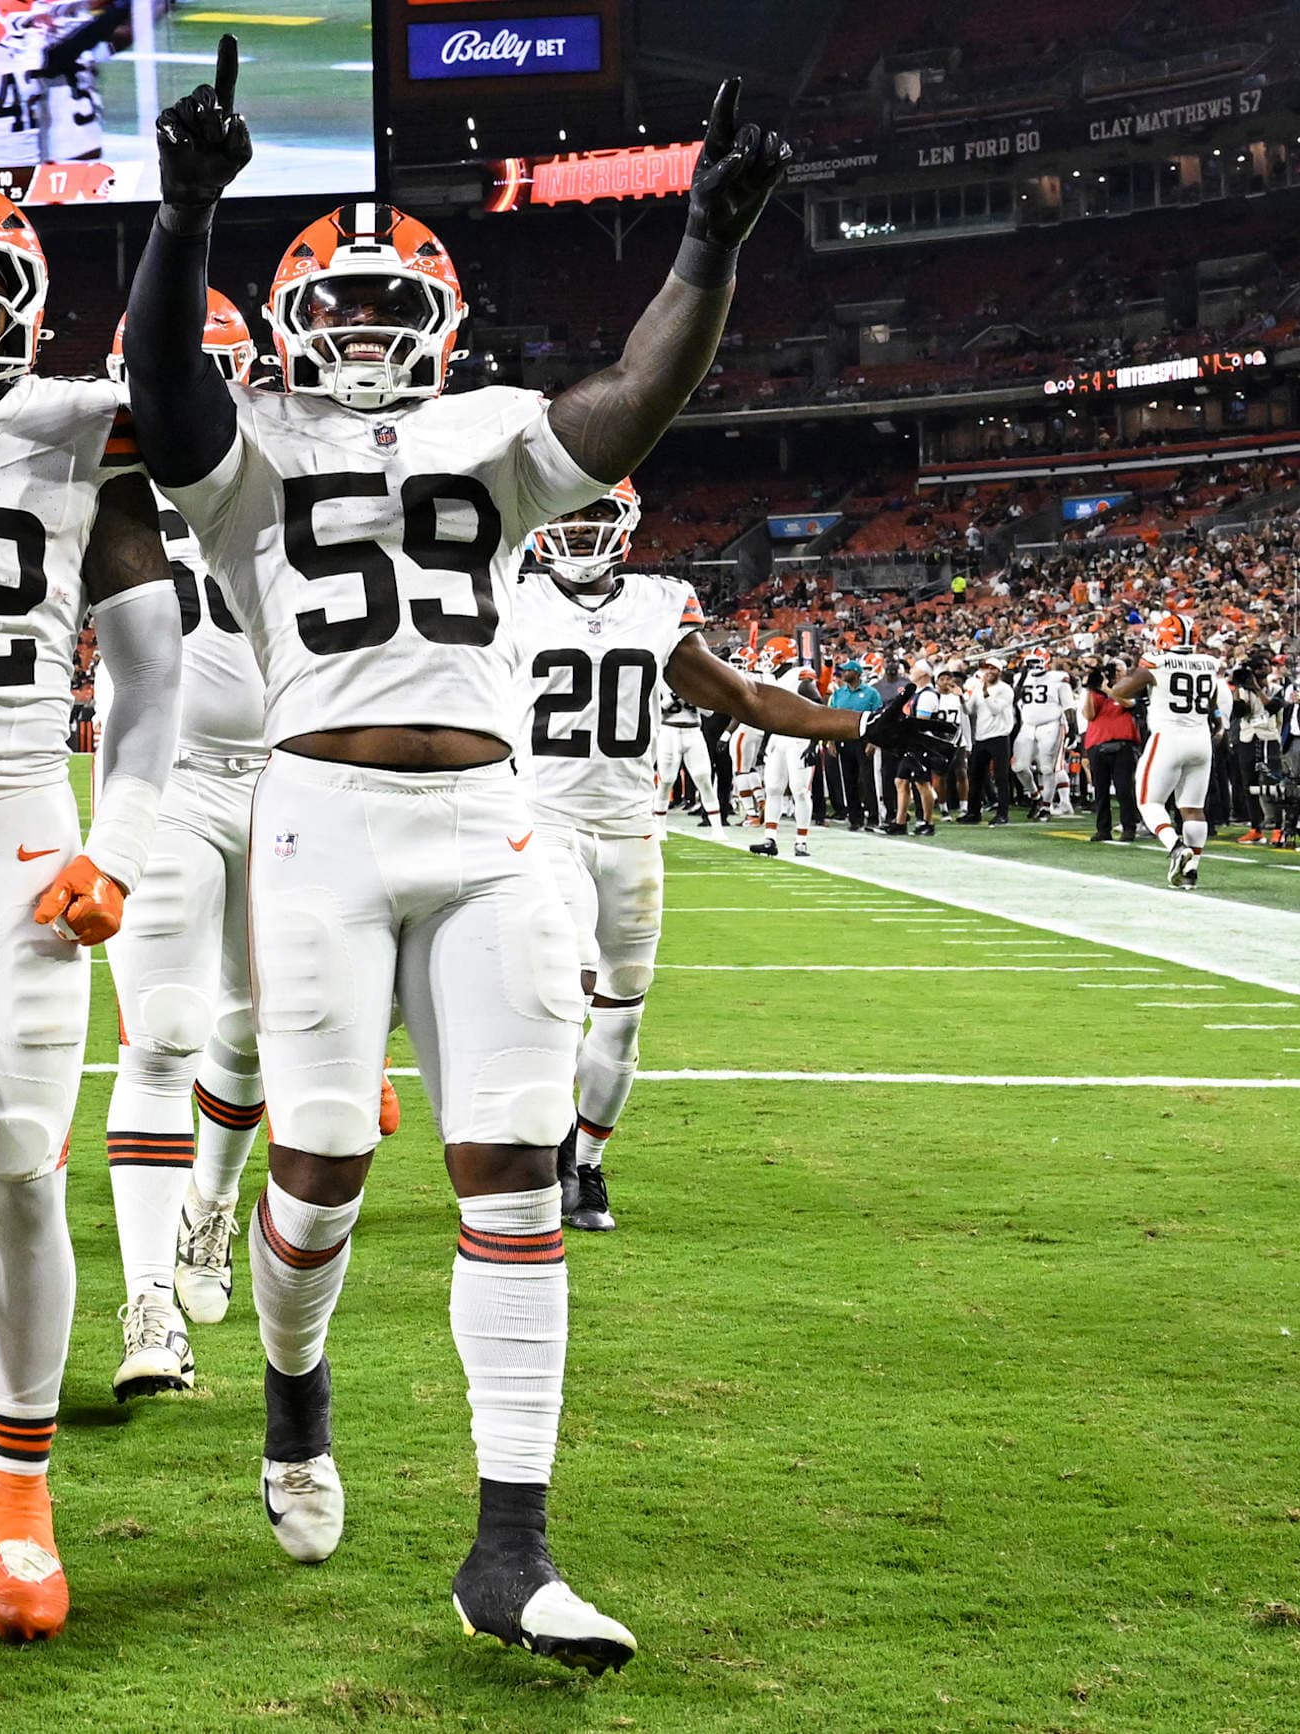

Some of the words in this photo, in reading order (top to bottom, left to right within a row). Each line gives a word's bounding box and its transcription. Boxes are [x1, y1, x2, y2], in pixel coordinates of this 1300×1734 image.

[441, 29, 532, 67] Bally
[536, 38, 566, 57] BET
[1089, 117, 1133, 141] CLAY
[1135, 96, 1232, 135] MATTHEWS
[1238, 89, 1263, 115] 57
[786, 154, 879, 176] CROSSCOUNTRY
[918, 146, 955, 167] LEN
[964, 137, 1010, 161] FORD
[1015, 131, 1041, 153] 80
[49, 171, 68, 195] 17
[282, 470, 503, 656] 59
[1164, 658, 1216, 671] HUNTINGTON
[531, 647, 658, 759] 20
[1021, 684, 1048, 705] 63
[1168, 671, 1213, 715] 98
